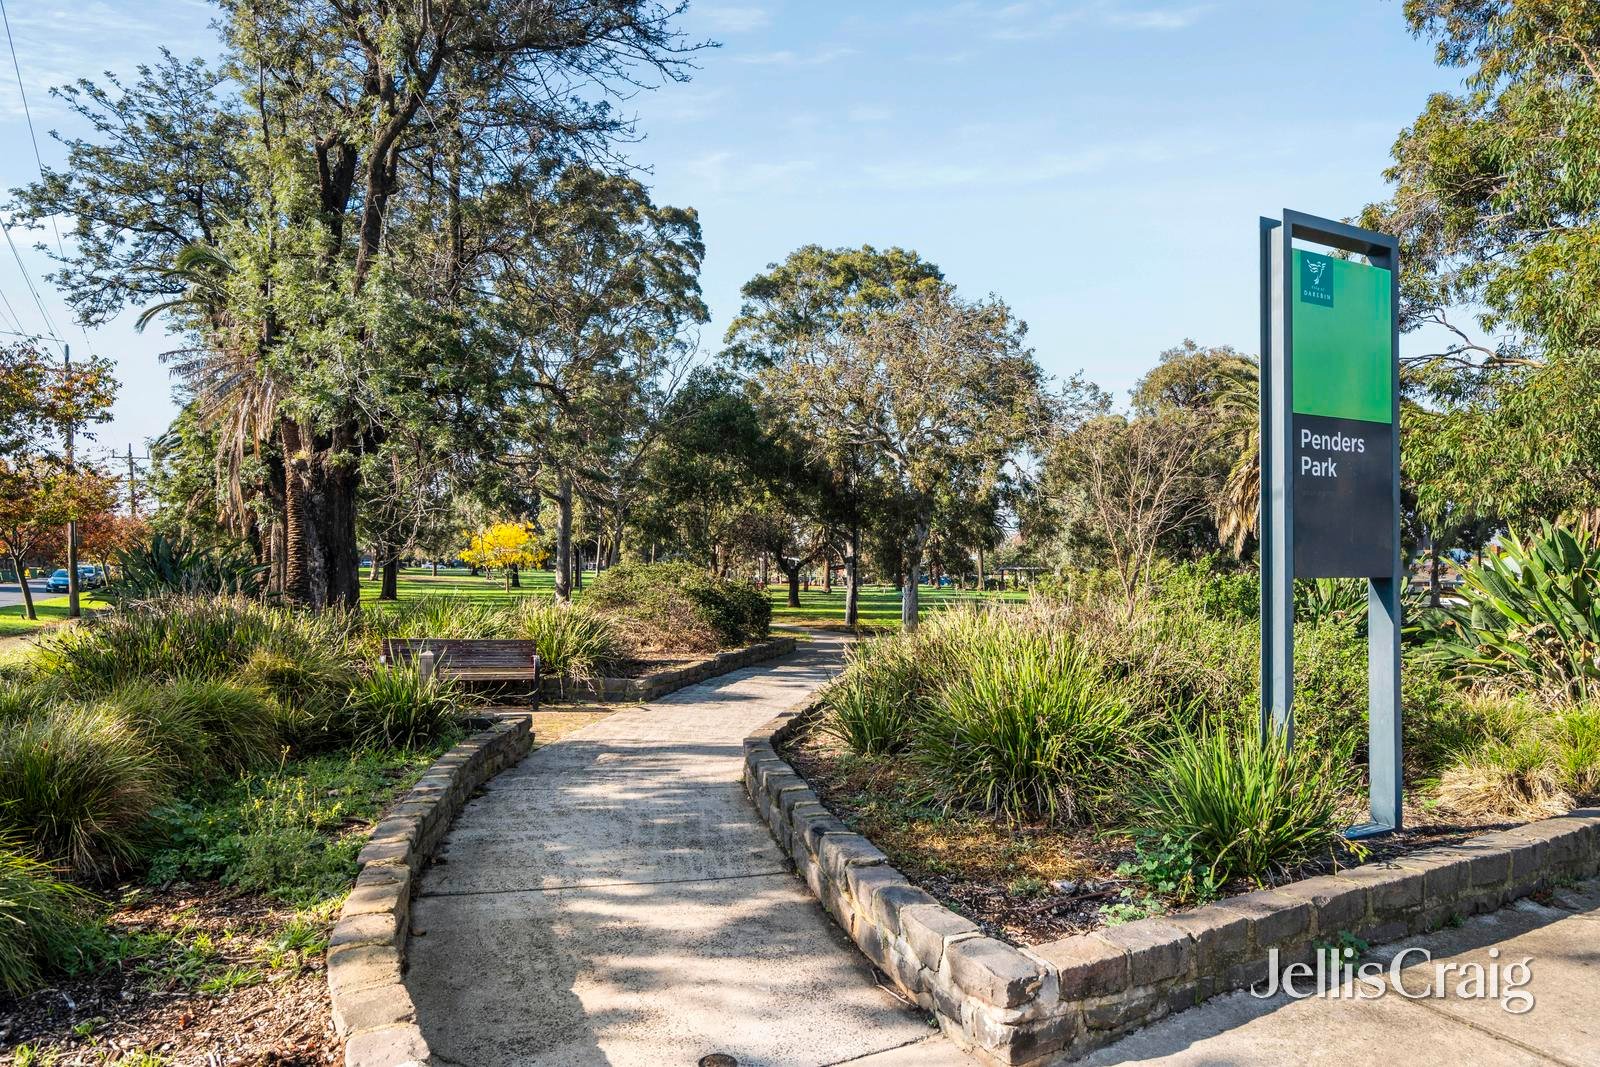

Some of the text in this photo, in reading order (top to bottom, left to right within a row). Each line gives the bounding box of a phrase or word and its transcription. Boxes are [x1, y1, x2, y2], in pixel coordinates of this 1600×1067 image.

[1303, 289, 1331, 300] DAREBIN
[1301, 429, 1365, 453] Penders
[1301, 456, 1338, 477] Park
